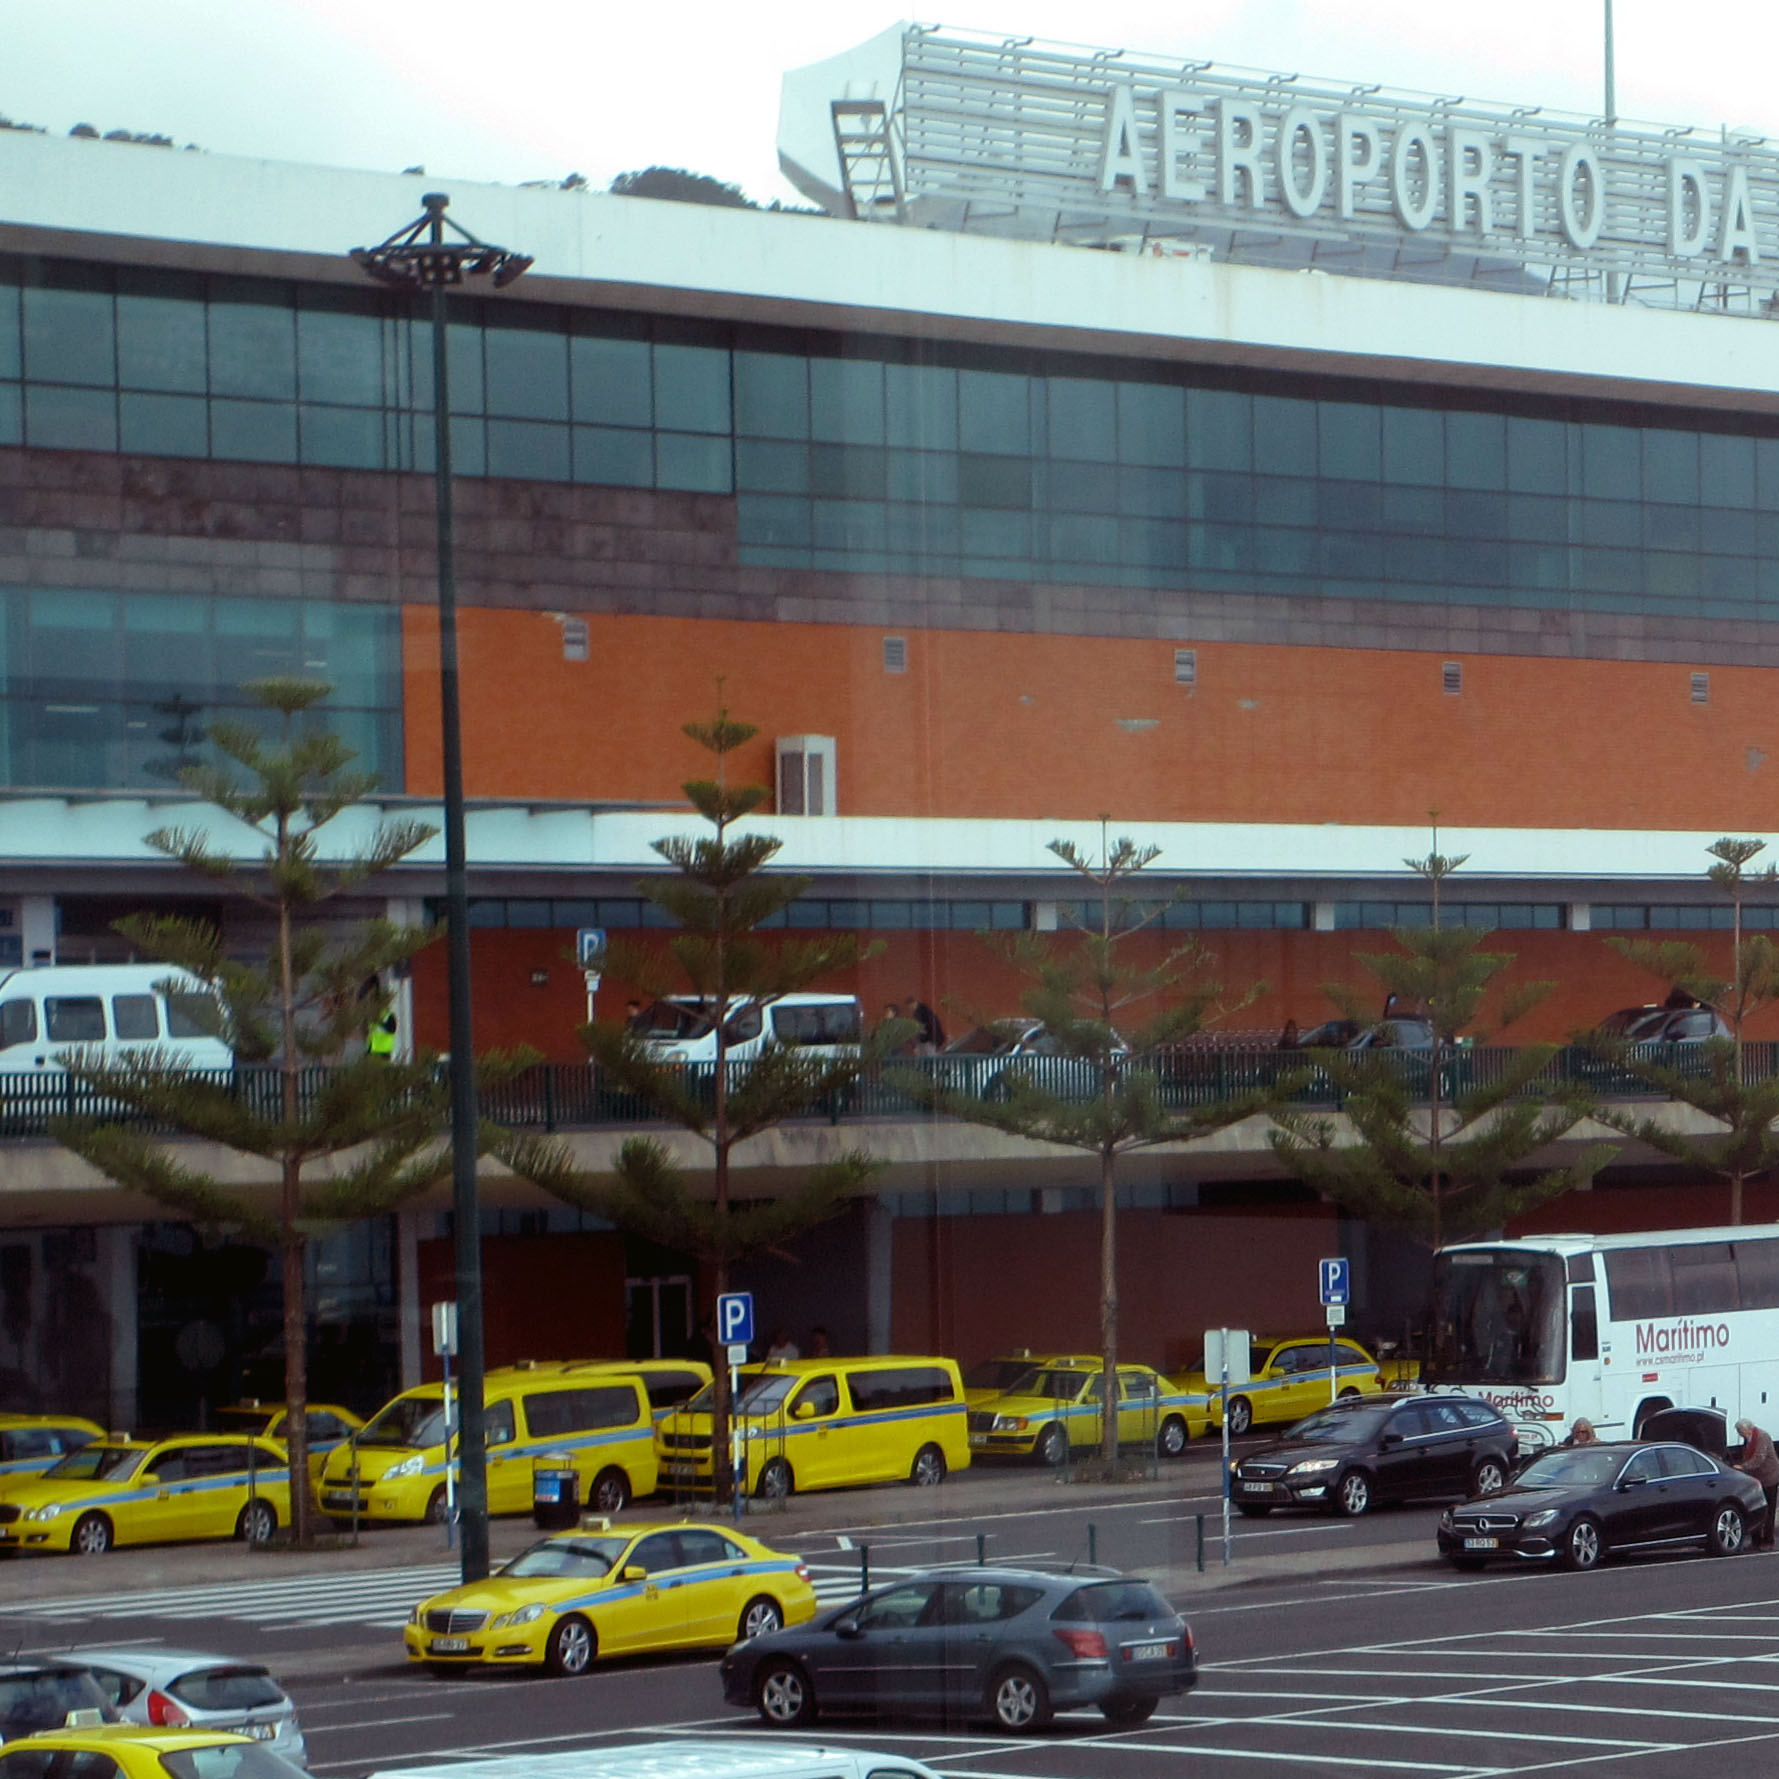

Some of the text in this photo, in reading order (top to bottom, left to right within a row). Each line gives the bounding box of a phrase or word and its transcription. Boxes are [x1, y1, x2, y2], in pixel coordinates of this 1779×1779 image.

[1102, 84, 1605, 250] AEROPORTO
[1666, 157, 1760, 266] DA
[583, 933, 599, 962] P
[1328, 1262, 1341, 1290] P
[725, 1300, 745, 1340] P
[1636, 1318, 1730, 1354] Marítimo
